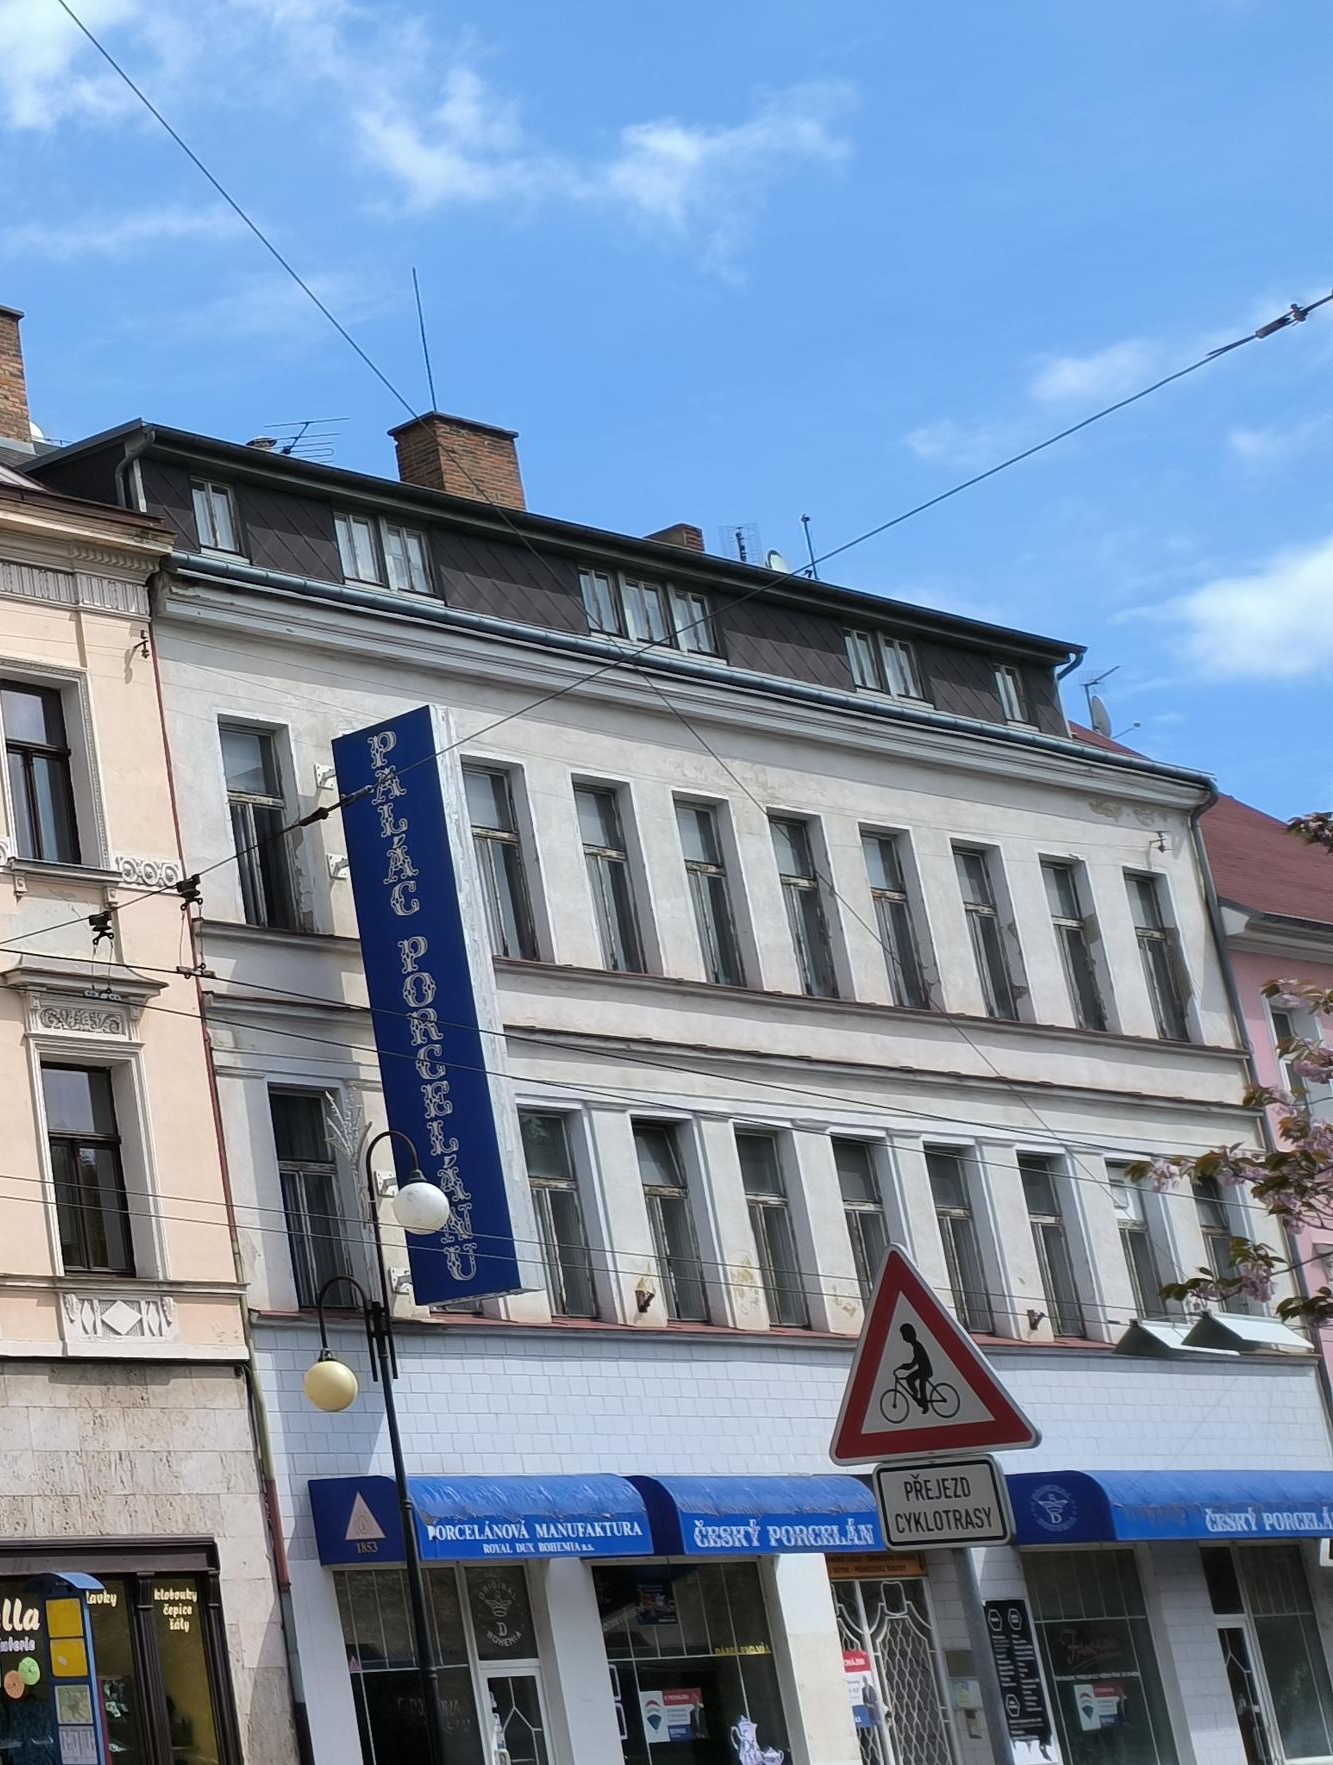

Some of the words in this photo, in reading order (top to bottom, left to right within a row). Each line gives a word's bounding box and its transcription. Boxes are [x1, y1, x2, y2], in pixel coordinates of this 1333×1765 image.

[367, 730, 419, 916] PALÁC
[398, 936, 477, 1281] PORCELÁNU
[904, 1473, 971, 1502] PŘEJEZD
[894, 1506, 993, 1534] CYKLOTRASY
[1204, 1507, 1258, 1533] ČESKÝ
[1262, 1506, 1333, 1532] PORCELÁ
[427, 1520, 530, 1542] PORCELÁNOVÁ
[534, 1520, 643, 1540] MANUFAKTURA
[693, 1518, 761, 1548] ČESKÝ
[766, 1517, 876, 1548] PORCELÁN
[356, 1541, 379, 1553] 1853
[482, 1542, 513, 1554] ROYAL
[515, 1542, 535, 1553] DUX
[537, 1542, 581, 1553] BOHEMIA
[85, 1588, 118, 1607] lavky
[153, 1587, 198, 1602] klobouky
[162, 1602, 193, 1618] čepice
[486, 1629, 523, 1648] BOHEMIA
